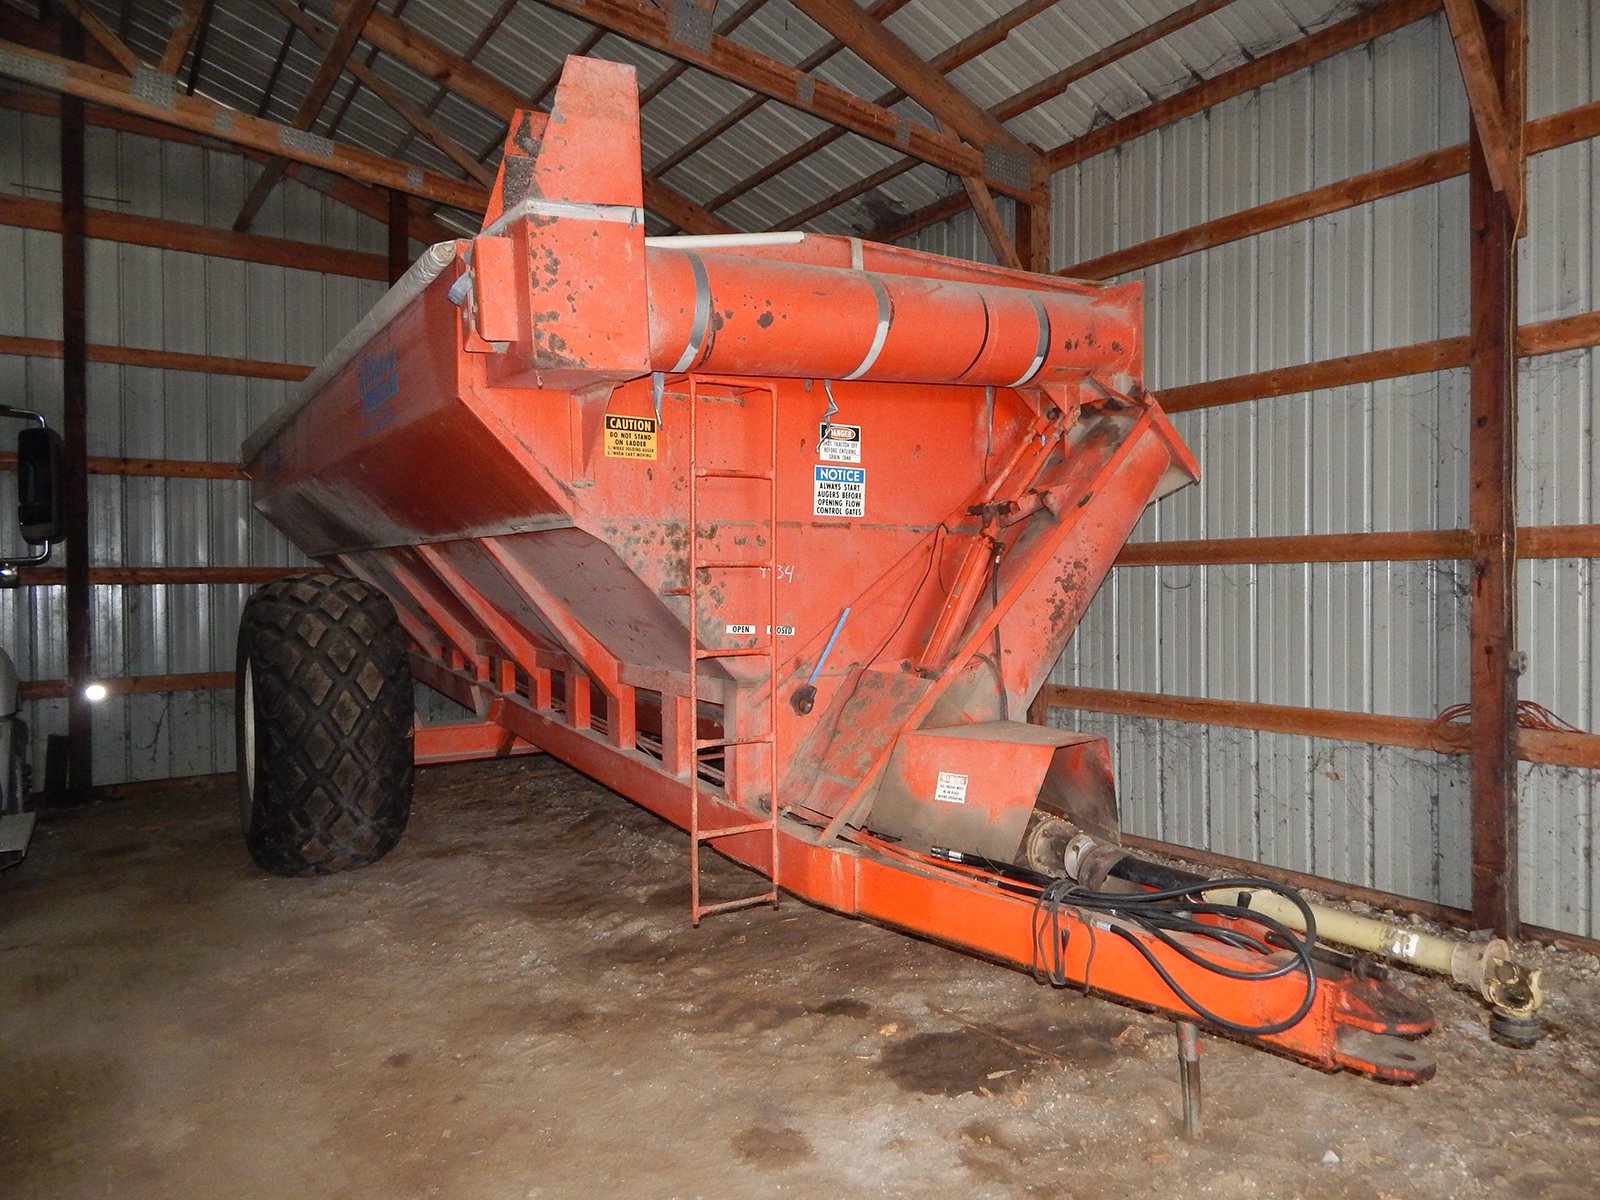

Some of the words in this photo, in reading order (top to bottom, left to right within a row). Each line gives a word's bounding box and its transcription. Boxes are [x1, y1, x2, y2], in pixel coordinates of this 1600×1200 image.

[610, 417, 651, 431] CAUTION
[820, 468, 860, 482] NOTICE
[819, 482, 841, 490] ALWAYS
[844, 483, 860, 491] START
[817, 490, 839, 499] AUGERS
[817, 498, 843, 507] OPENING
[816, 506, 842, 515] CONTROL
[732, 625, 750, 633] OPEN
